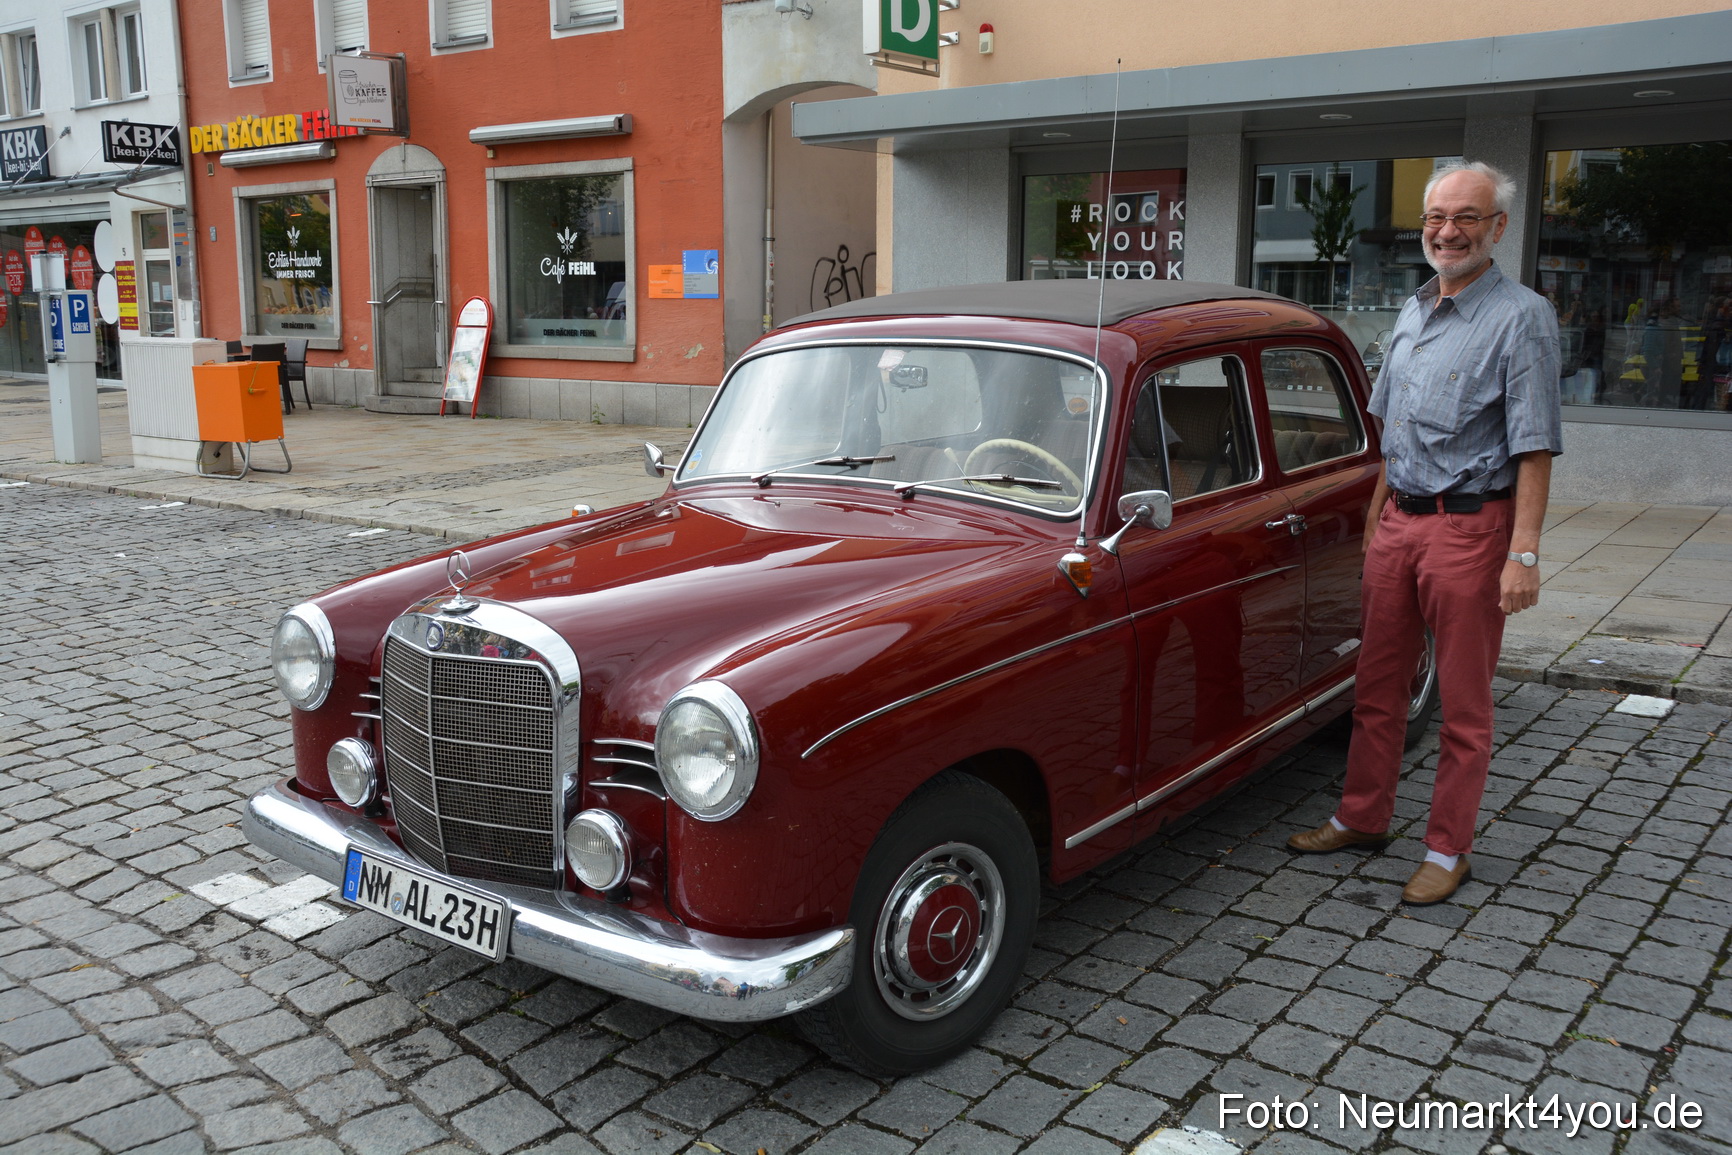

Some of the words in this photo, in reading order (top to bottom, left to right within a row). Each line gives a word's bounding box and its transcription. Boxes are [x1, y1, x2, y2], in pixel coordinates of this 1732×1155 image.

[355, 88, 387, 97] KAFFEE
[110, 124, 176, 149] KBK
[190, 124, 224, 154] DER
[227, 114, 299, 150] BÄCKER
[2, 129, 41, 160] KBK
[1071, 200, 1185, 223] #ROCK
[1087, 231, 1184, 251] YOUR
[289, 250, 322, 267] Handwerk
[276, 270, 294, 279] IMMER
[295, 270, 316, 278] FRISCH
[540, 257, 566, 285] Café
[1087, 261, 1183, 280] LOOK
[73, 299, 85, 318] P
[348, 880, 354, 891] D
[358, 861, 393, 908] NM
